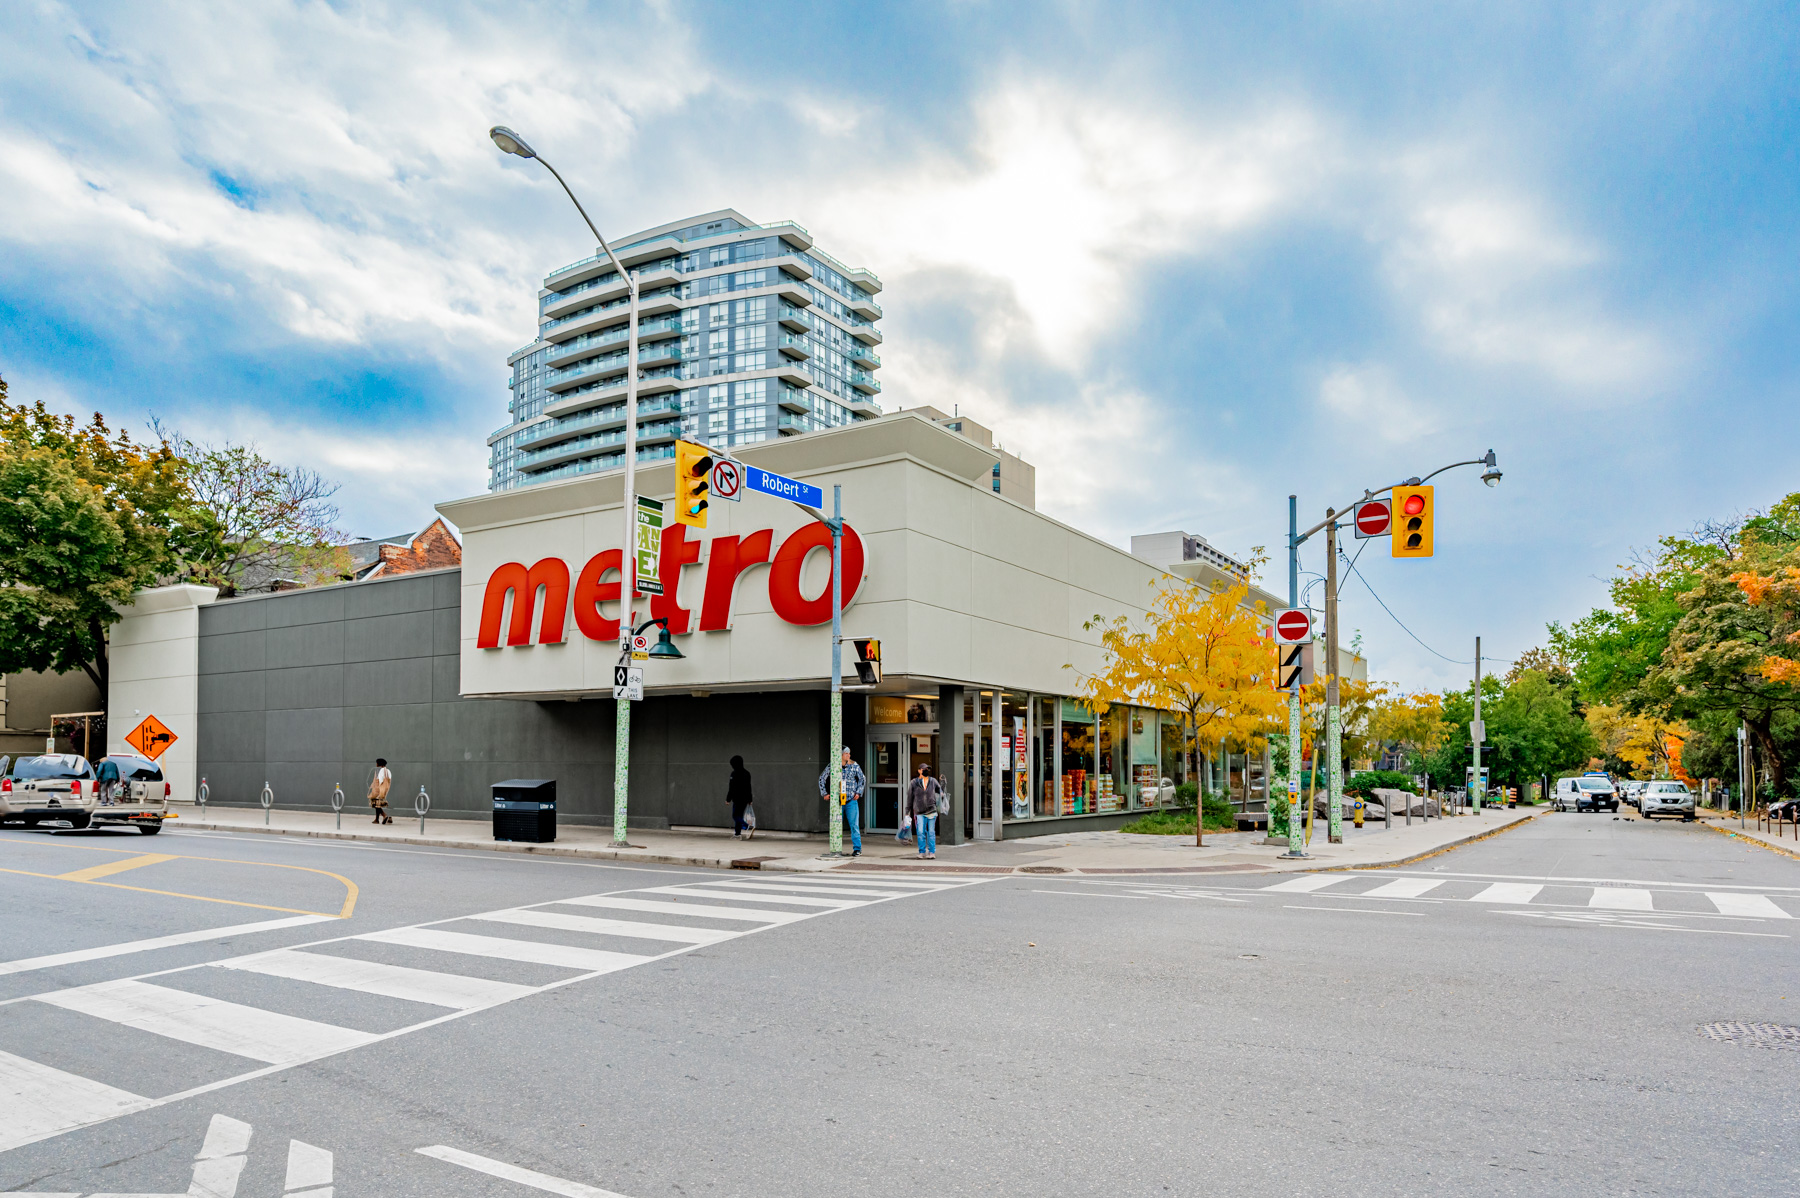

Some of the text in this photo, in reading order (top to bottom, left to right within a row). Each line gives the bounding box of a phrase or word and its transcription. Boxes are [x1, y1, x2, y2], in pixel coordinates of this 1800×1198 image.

[761, 472, 799, 498] Robert
[638, 512, 650, 524] the
[477, 520, 867, 650] metro
[873, 706, 903, 718] Welcome
